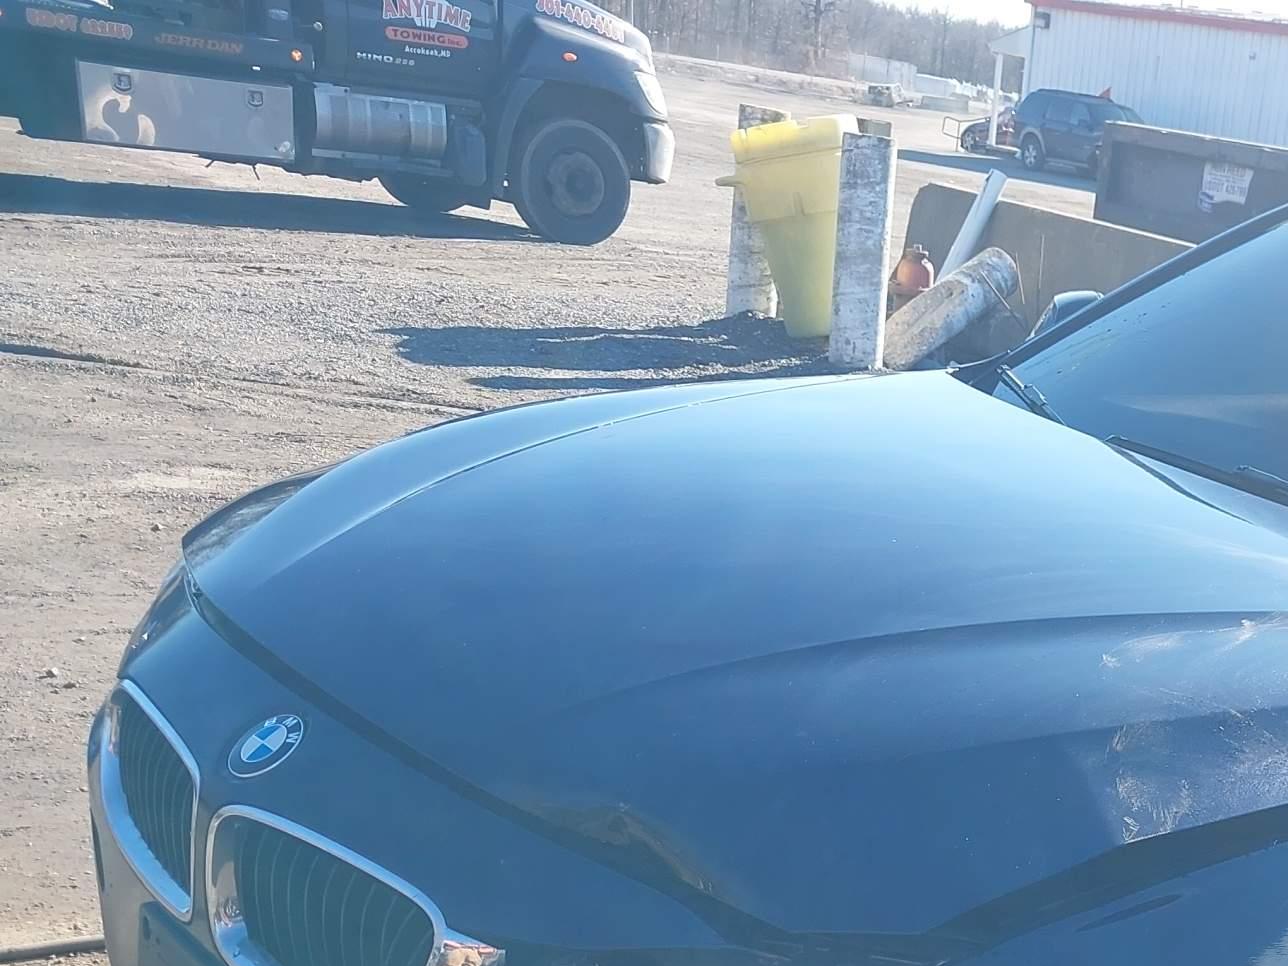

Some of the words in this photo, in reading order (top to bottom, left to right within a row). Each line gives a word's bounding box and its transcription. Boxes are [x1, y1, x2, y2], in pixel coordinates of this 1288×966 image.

[382, 0, 472, 32] ANYTIME
[391, 28, 446, 44] TOWING
[356, 51, 394, 64] HINO
